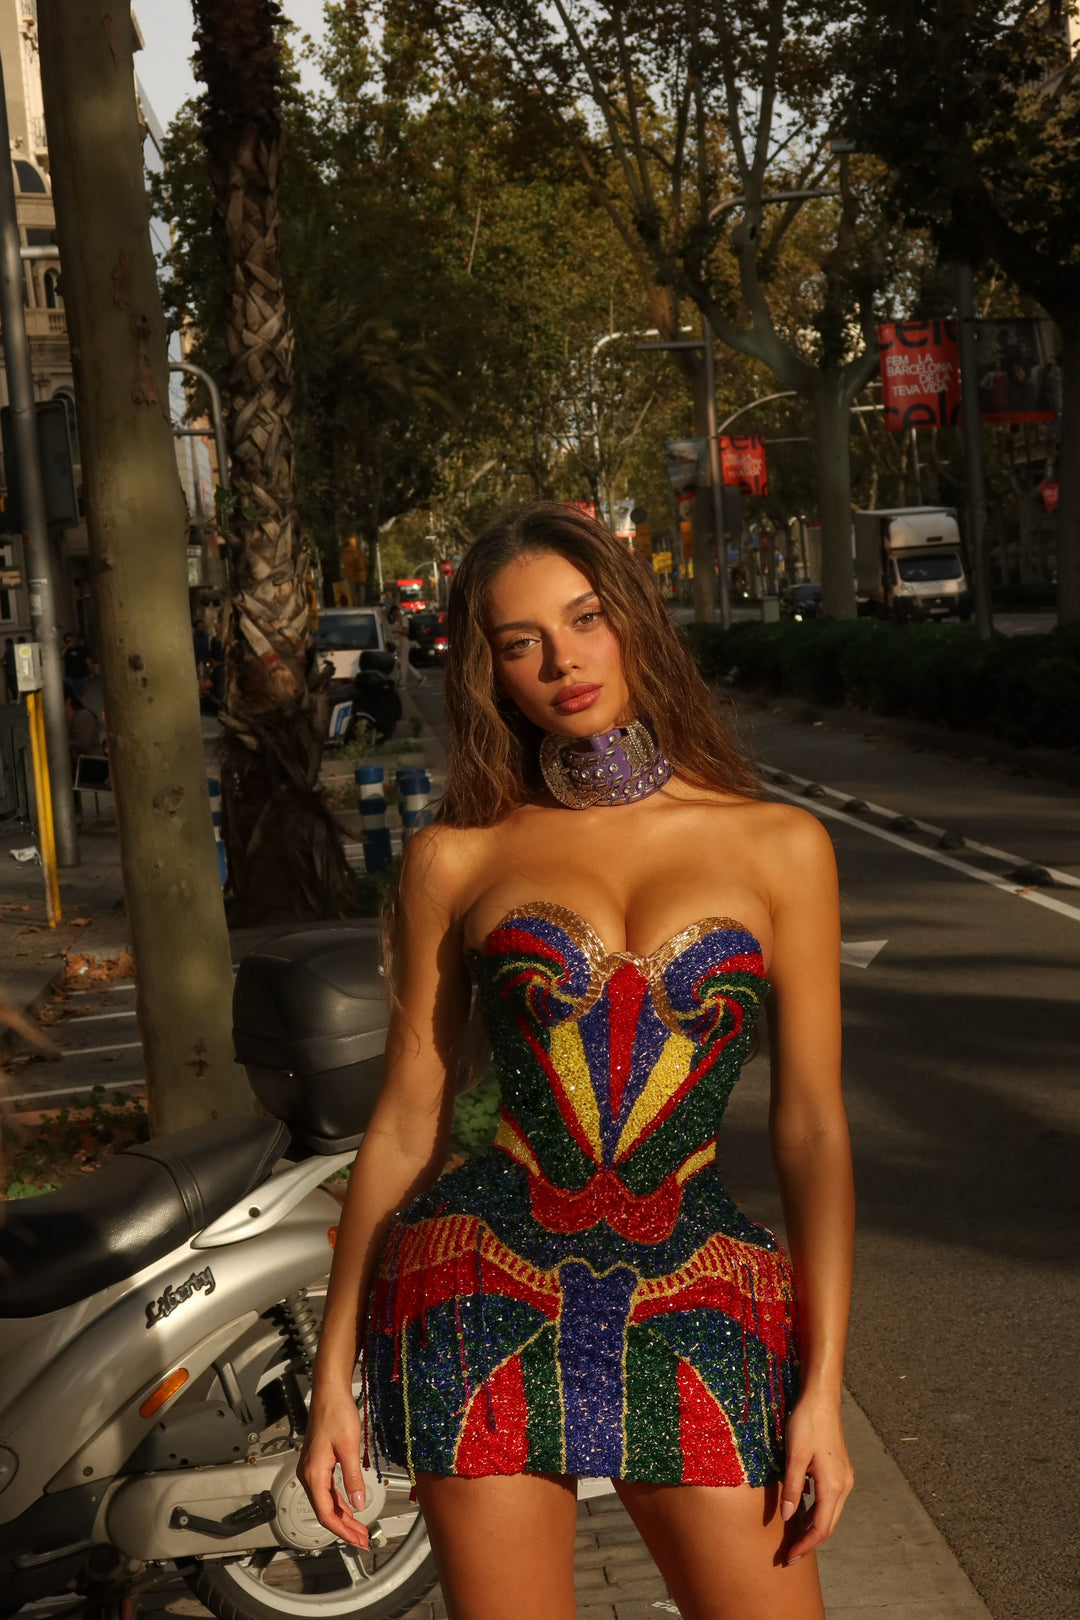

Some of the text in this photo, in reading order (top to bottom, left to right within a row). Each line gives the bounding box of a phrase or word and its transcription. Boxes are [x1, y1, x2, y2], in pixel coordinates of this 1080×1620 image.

[886, 353, 933, 367] FEM LA
[886, 362, 953, 377] BARCELONA
[919, 371, 951, 384] DE LA
[891, 382, 948, 396] TEVA VIDA
[145, 1265, 216, 1329] Liberty
